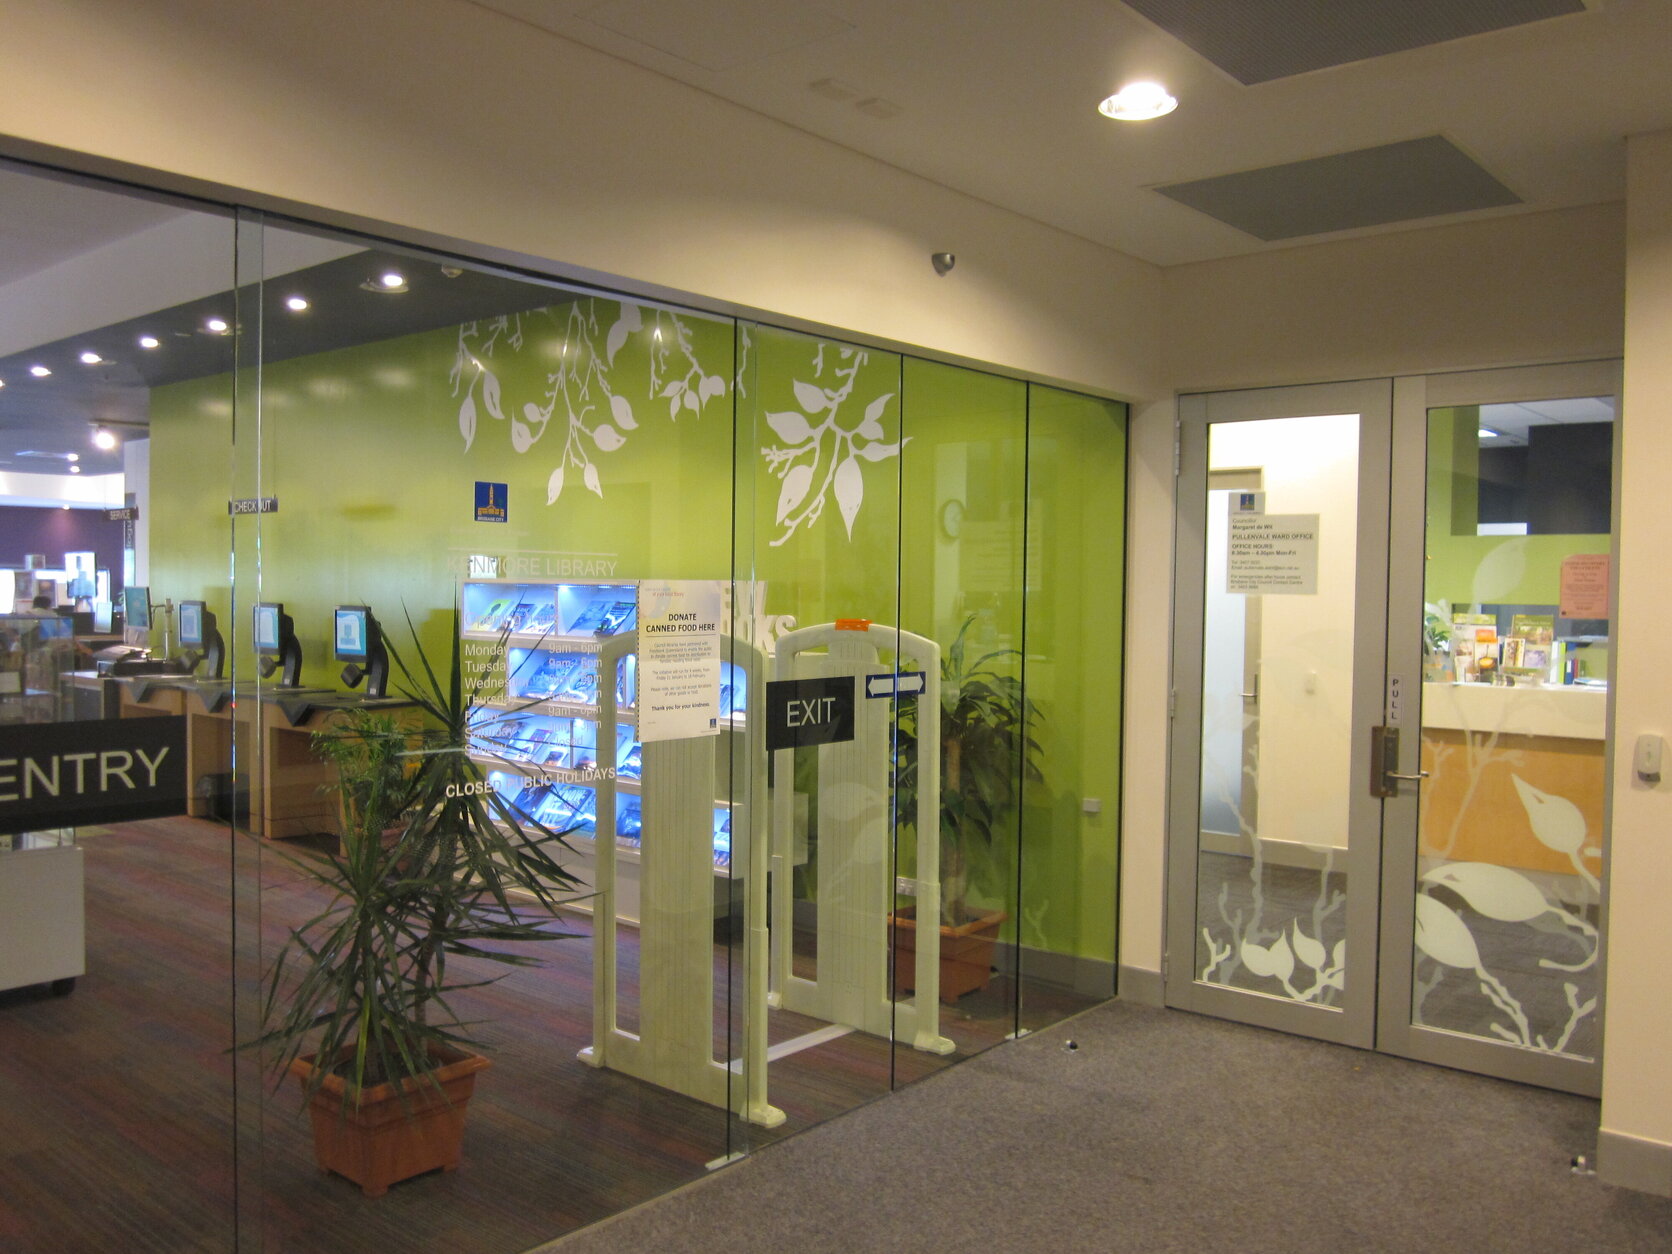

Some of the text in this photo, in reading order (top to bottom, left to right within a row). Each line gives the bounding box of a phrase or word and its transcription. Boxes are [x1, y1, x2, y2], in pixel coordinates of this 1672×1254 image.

[233, 500, 256, 513] CHECK
[110, 508, 131, 521] SERVICE
[546, 557, 618, 577] LIBRARY
[668, 613, 697, 621] DONATE
[645, 623, 715, 633] CANNED FOOD HERE
[465, 643, 509, 657] Monday
[549, 642, 571, 654] 9am
[581, 643, 603, 655] 6pm
[465, 660, 509, 674] Tuesda
[465, 692, 519, 708] Thursday
[1391, 678, 1400, 720] PULL
[786, 697, 836, 728] EXIT
[0, 746, 169, 802] ENTRY
[446, 780, 502, 798] CLOSED
[556, 767, 616, 785] HOLIDAYS
